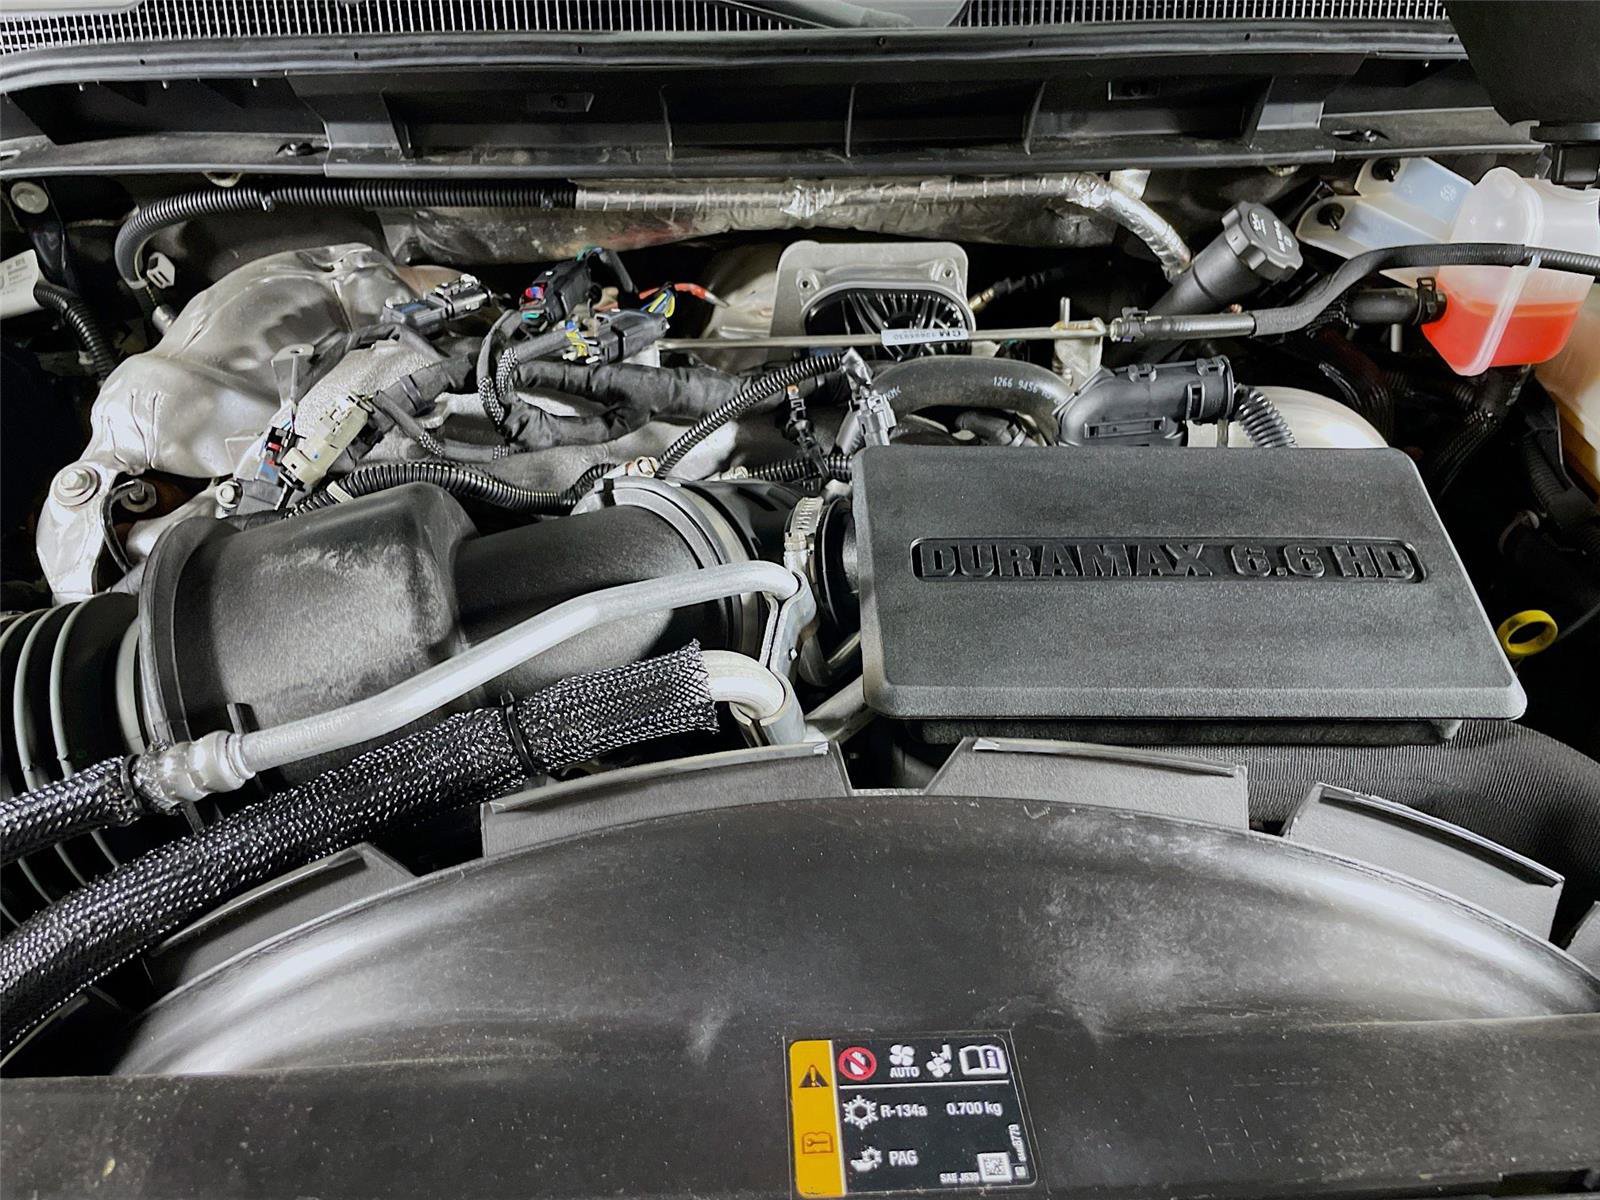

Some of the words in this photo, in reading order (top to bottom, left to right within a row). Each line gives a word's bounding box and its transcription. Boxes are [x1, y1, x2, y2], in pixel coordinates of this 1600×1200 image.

[922, 543, 1213, 577] DURAMAX
[1230, 543, 1326, 578] 6.6
[1332, 543, 1416, 579] HD
[889, 1067, 920, 1078] AUTO
[880, 1104, 928, 1117] R-134a
[946, 1102, 983, 1116] 0.700
[985, 1102, 1003, 1117] kg
[889, 1151, 919, 1166] PAG
